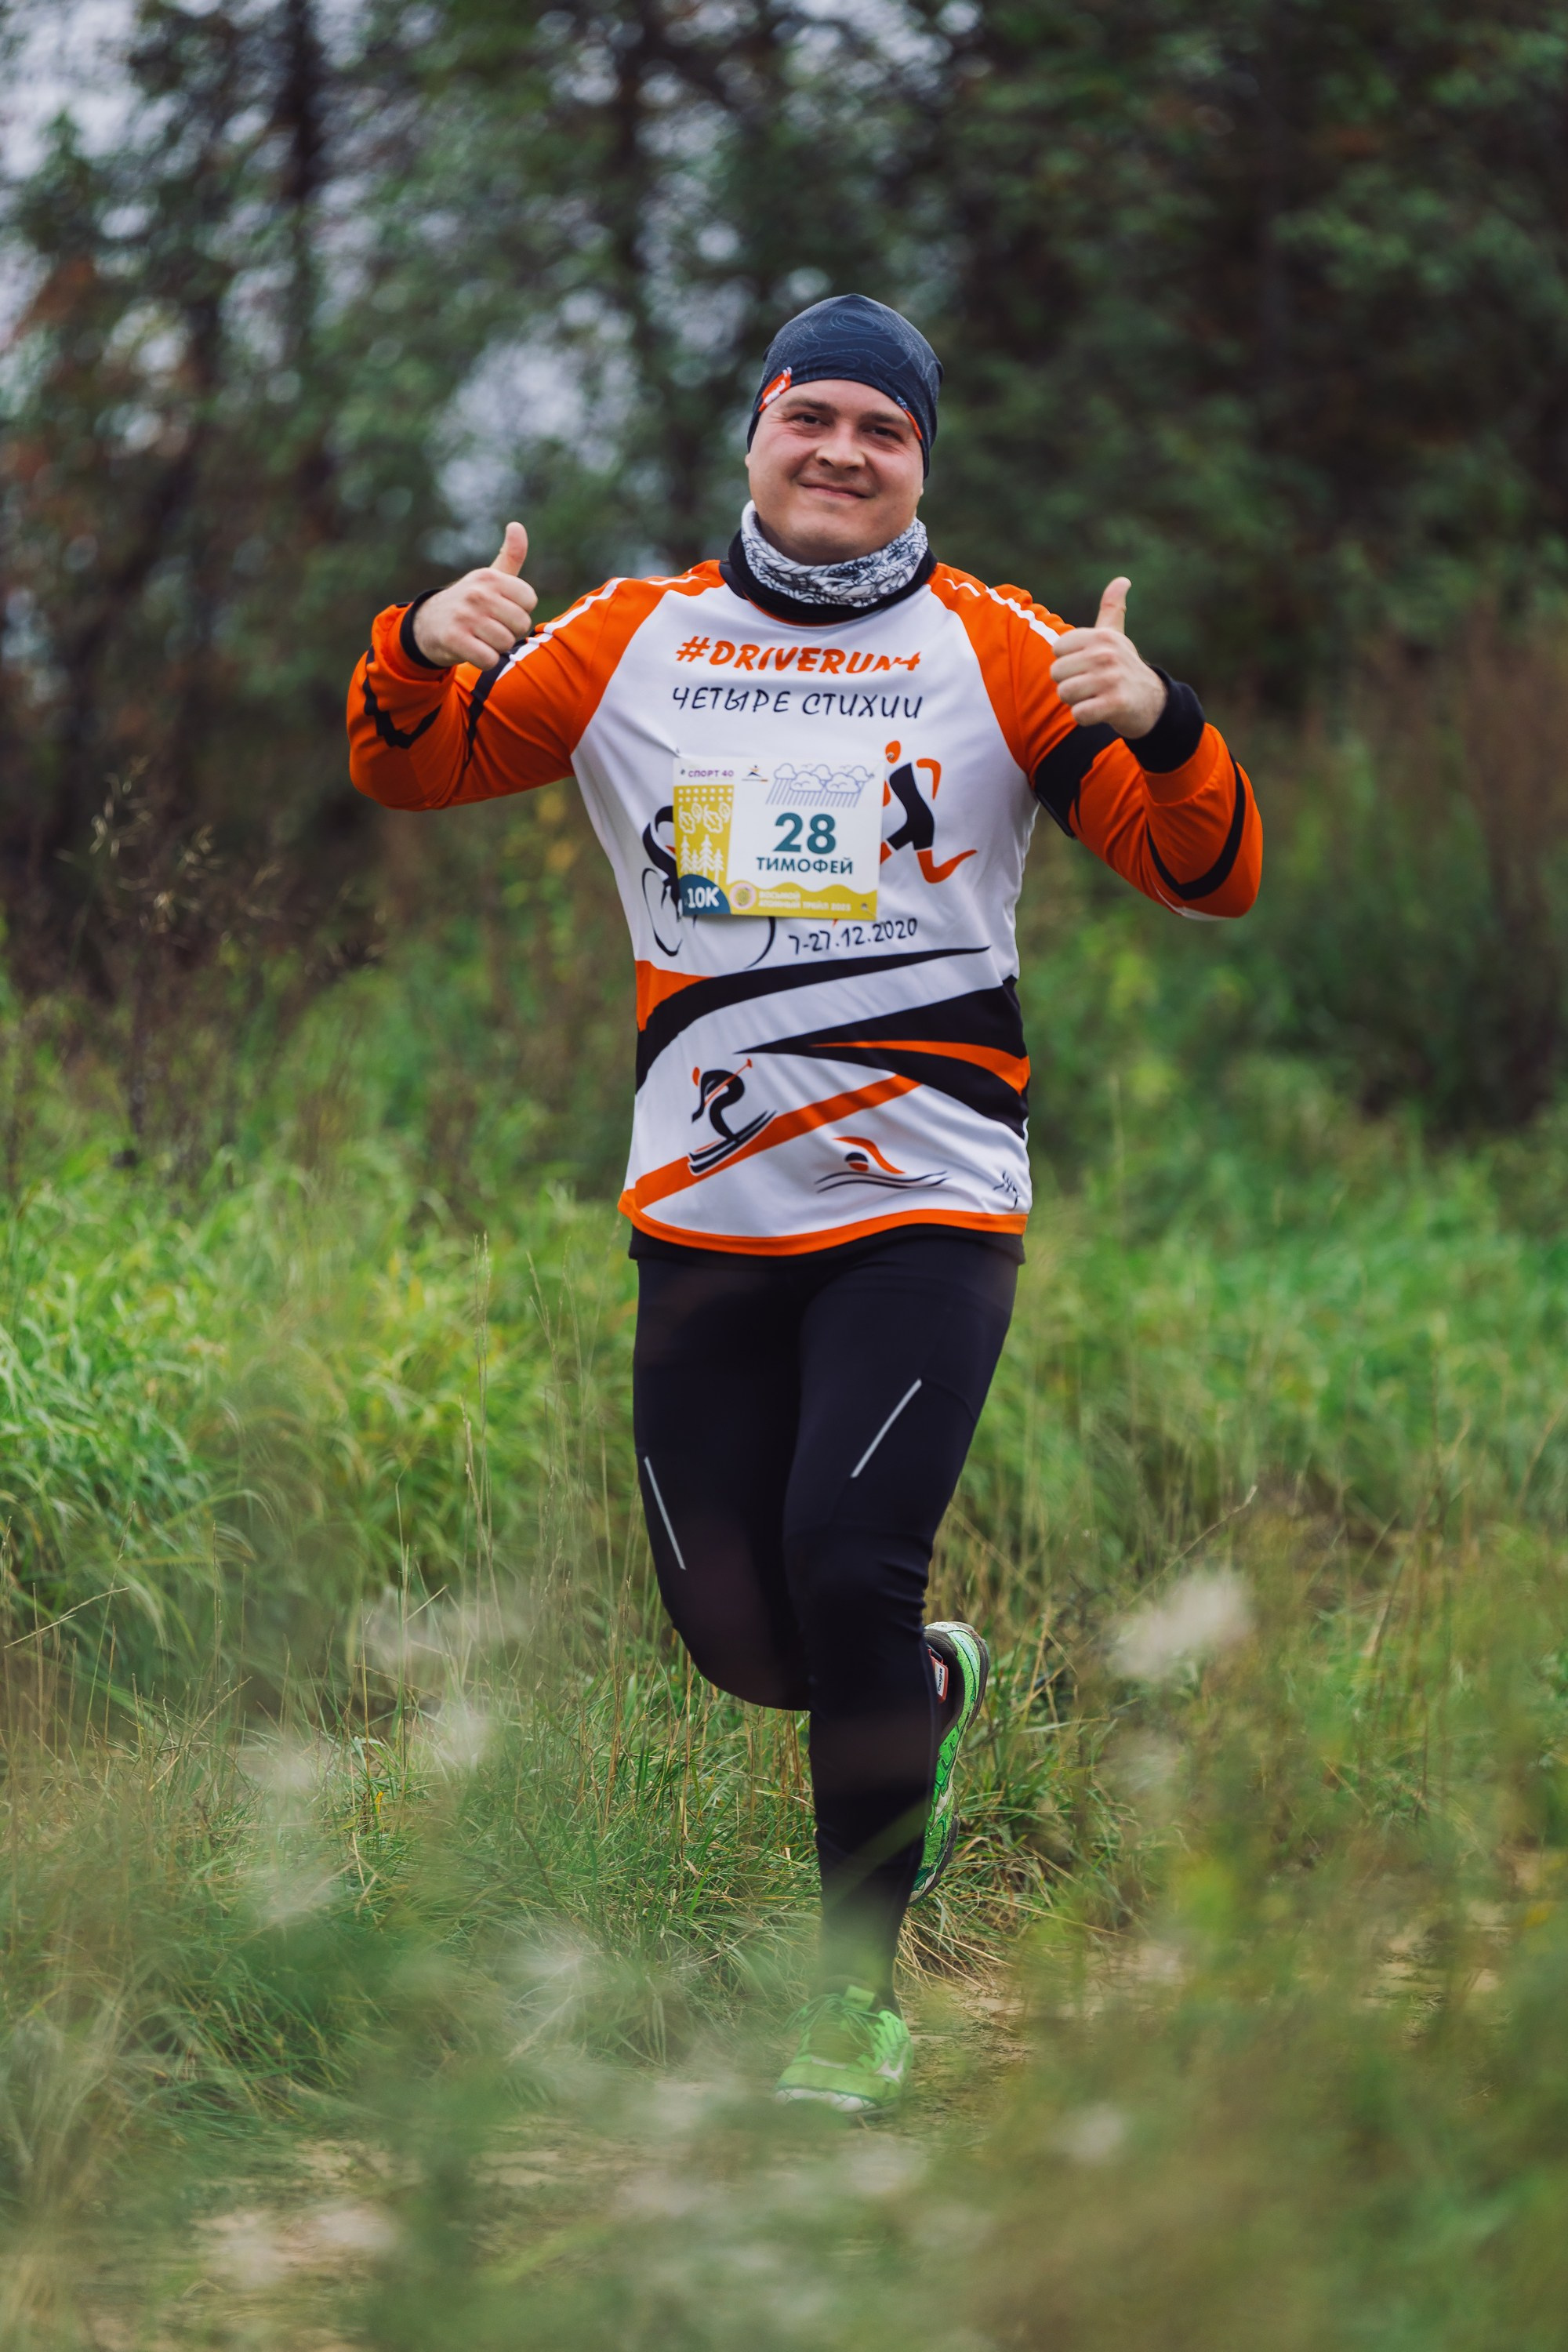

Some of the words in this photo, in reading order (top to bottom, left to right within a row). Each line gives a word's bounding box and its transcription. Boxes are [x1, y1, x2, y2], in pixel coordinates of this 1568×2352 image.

[673, 687, 791, 713] ЧЕТЫРЕ
[802, 693, 924, 719] СТИХИИ
[688, 769, 719, 778] СПОРТ
[773, 812, 837, 855] 28
[756, 857, 853, 875] ТИМОФЕЙ
